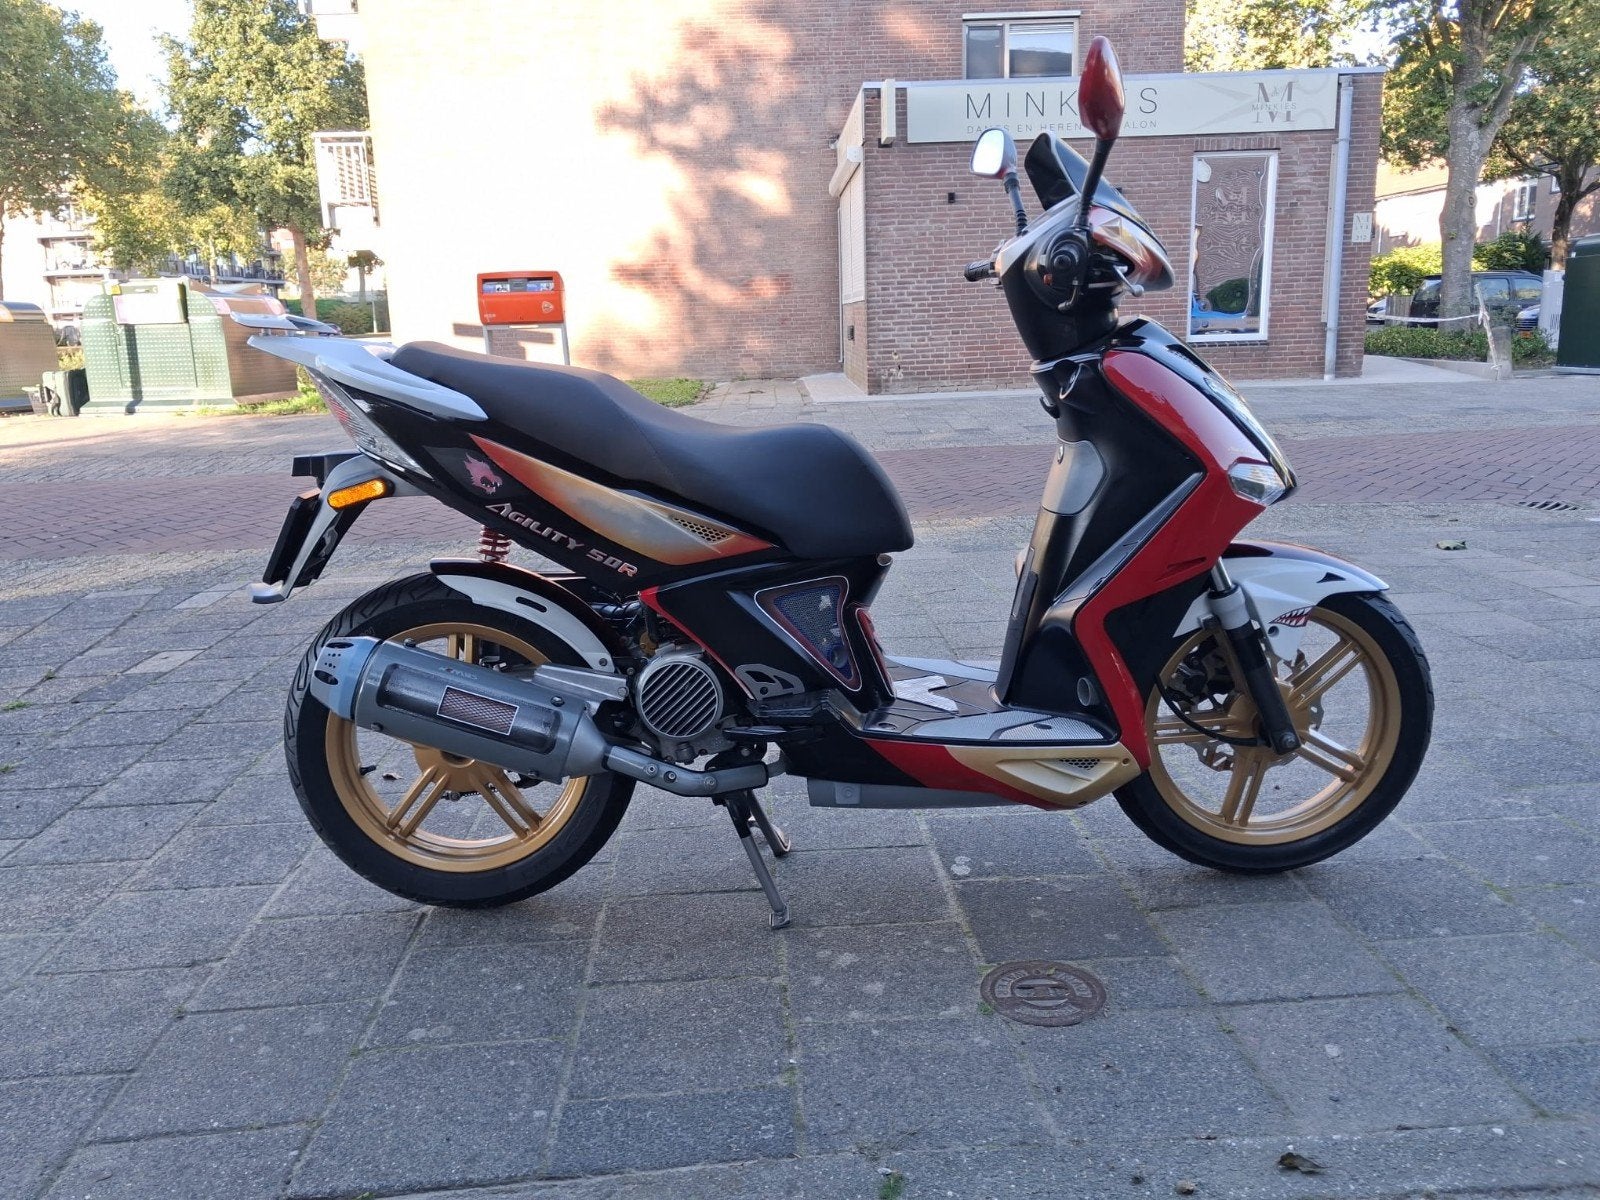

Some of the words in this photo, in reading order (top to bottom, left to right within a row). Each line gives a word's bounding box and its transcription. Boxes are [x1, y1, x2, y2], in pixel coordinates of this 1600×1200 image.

[966, 87, 1158, 119] MINKS
[967, 124, 1010, 133] DAS
[1017, 124, 1032, 132] EN
[1041, 122, 1082, 132] HEREN
[485, 502, 585, 551] AGILITY
[586, 548, 639, 577] 50R
